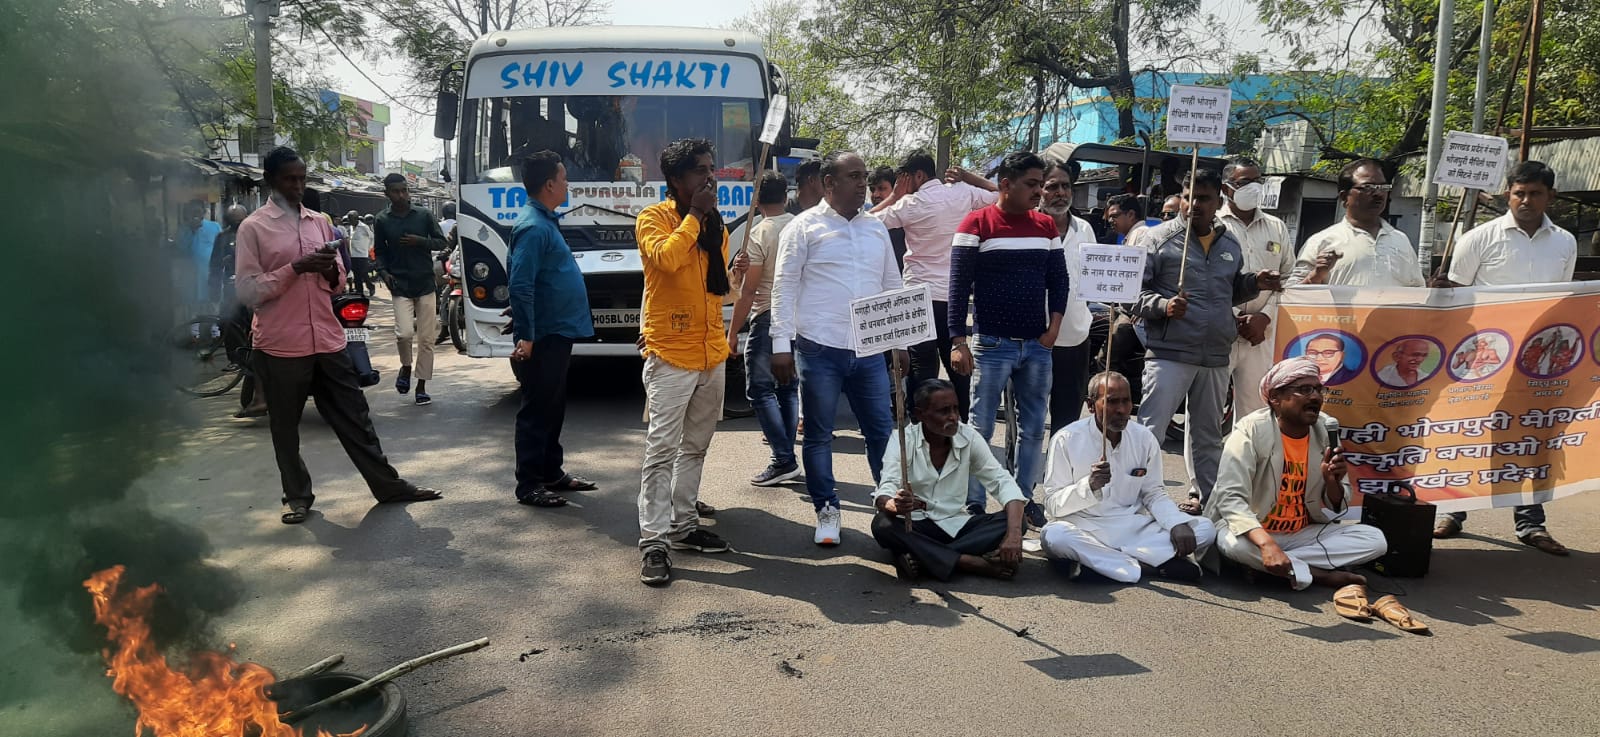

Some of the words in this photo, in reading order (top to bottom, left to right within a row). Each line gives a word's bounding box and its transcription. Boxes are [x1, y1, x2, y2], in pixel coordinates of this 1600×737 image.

[500, 60, 583, 89] SHIV
[607, 60, 730, 89] SHAKTI
[1190, 111, 1204, 119] भाषा
[572, 186, 656, 199] PURULIA
[497, 212, 518, 220] DEP
[597, 231, 633, 240] TATA
[1085, 253, 1113, 263] झारखंड
[1123, 256, 1140, 264] भाषा
[1081, 265, 1089, 276] के
[1091, 268, 1105, 278] नाम
[1106, 269, 1117, 278] पर
[871, 298, 892, 313] भोजपुरी
[912, 293, 925, 301] भाषा
[591, 314, 622, 325] H05BL
[859, 320, 867, 331] को
[868, 319, 886, 329] धनबाद
[886, 313, 904, 326] बोकारो
[905, 310, 911, 320] के
[1290, 313, 1312, 324] जय
[861, 336, 874, 345] भाषा
[874, 335, 882, 343] का
[883, 329, 894, 341] दर्जा
[911, 325, 917, 334] के
[1398, 412, 1511, 437] भोजपुरी
[1437, 436, 1541, 462] बचाओ
[1547, 432, 1587, 450] मंच
[1479, 462, 1551, 485] प्रदेश
